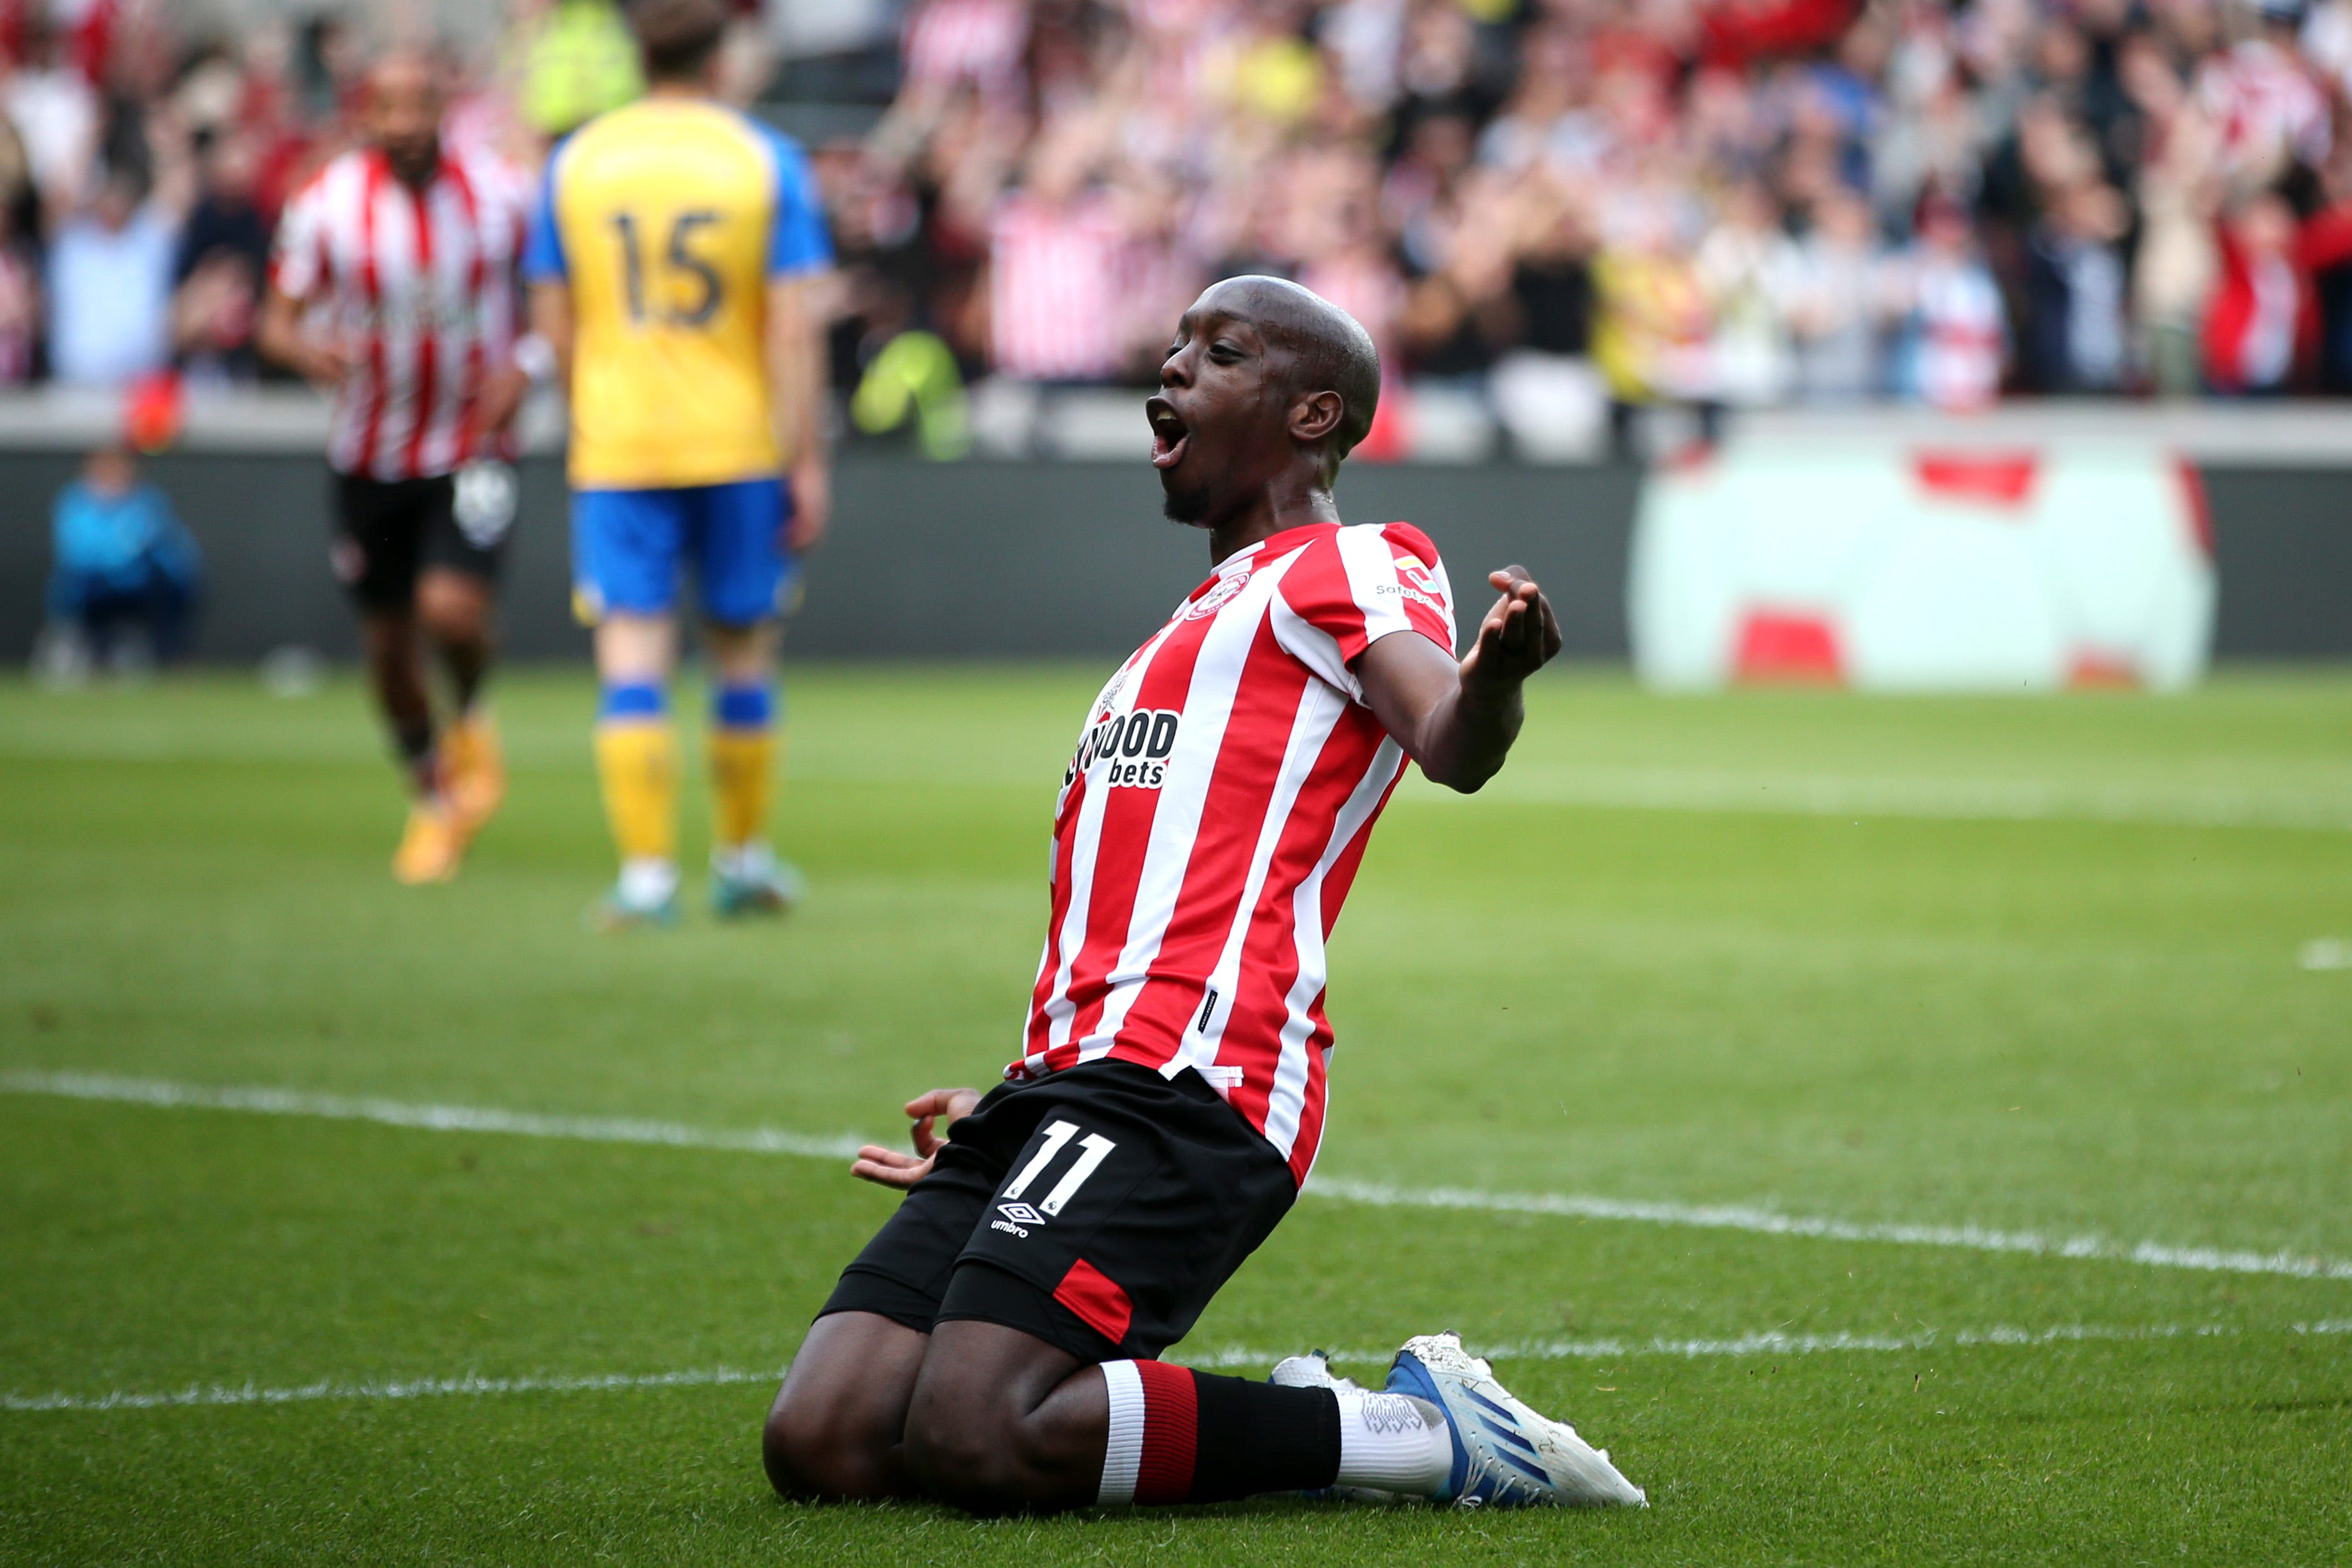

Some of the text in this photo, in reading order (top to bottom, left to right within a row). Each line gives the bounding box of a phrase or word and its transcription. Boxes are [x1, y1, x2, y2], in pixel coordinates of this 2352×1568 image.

[614, 213, 724, 328] 15
[1108, 757, 1164, 785] bets
[1001, 1119, 1118, 1217] 11
[991, 1219, 1029, 1239] umbro
